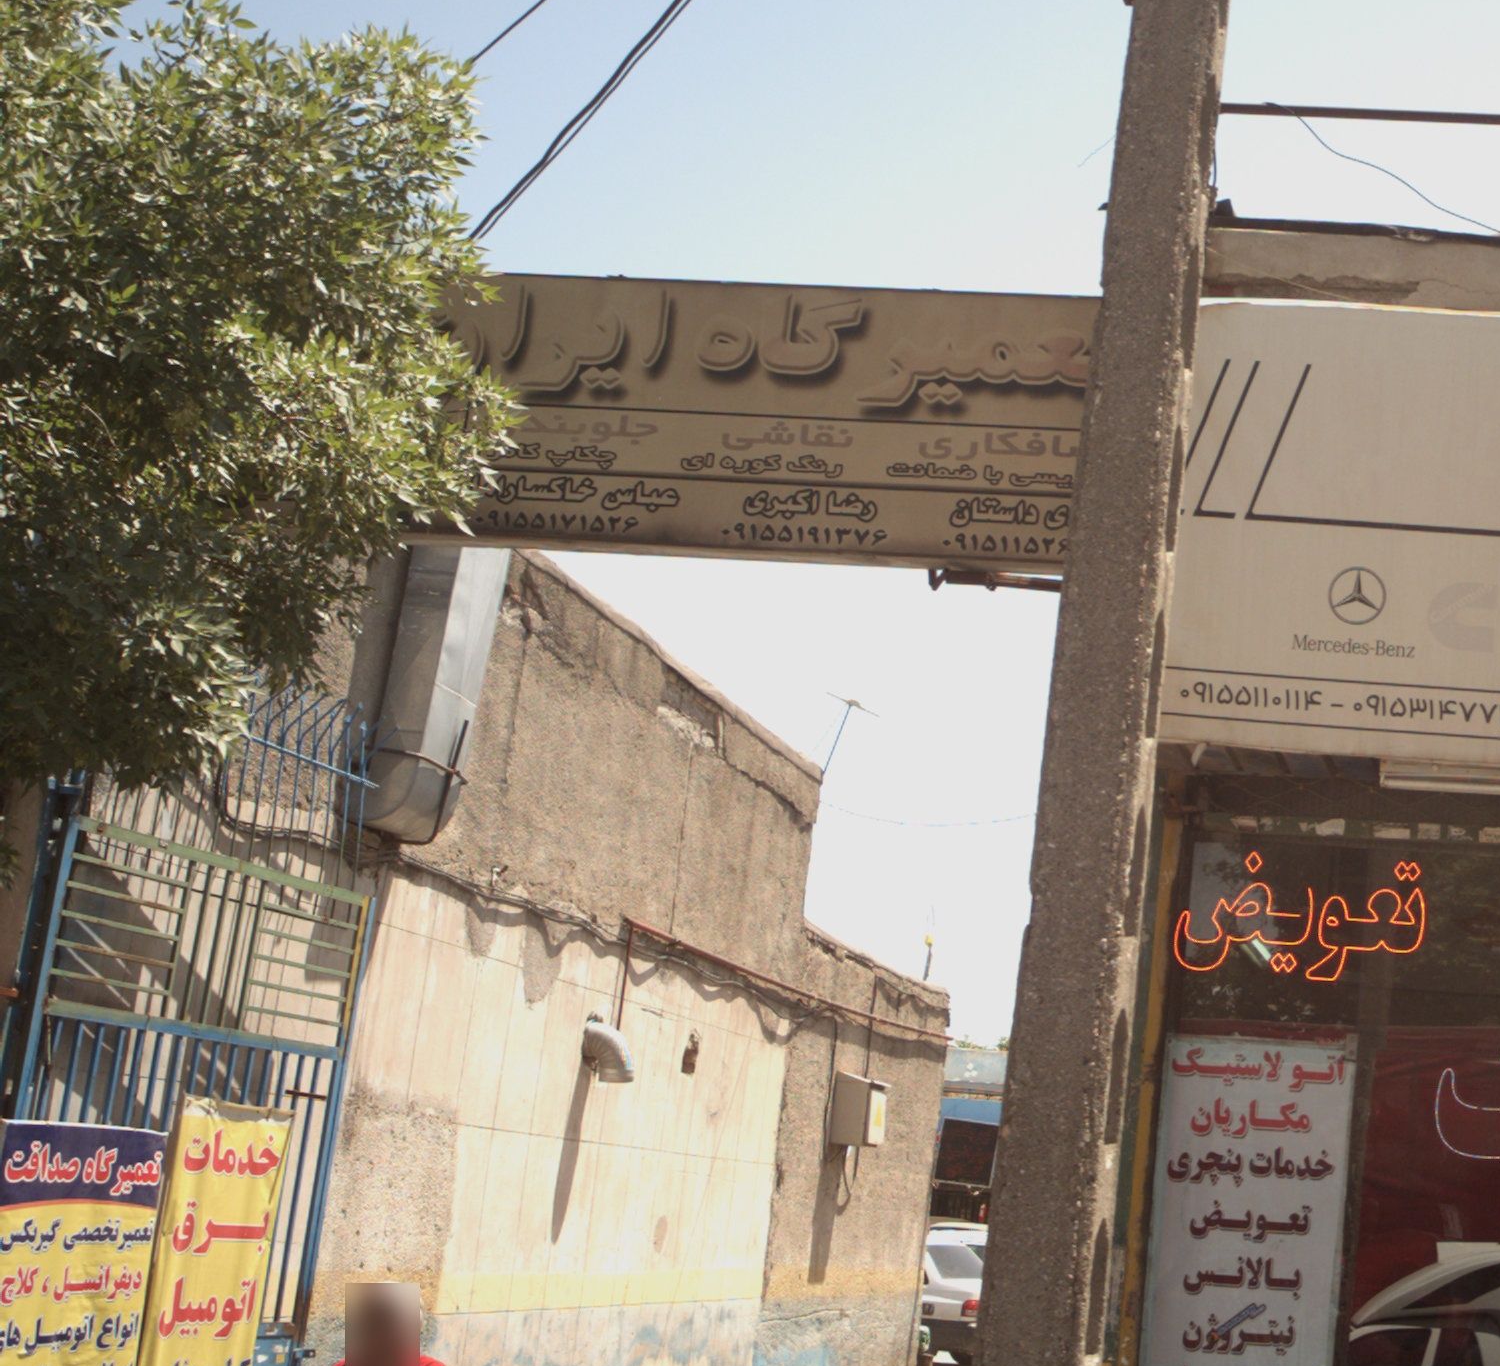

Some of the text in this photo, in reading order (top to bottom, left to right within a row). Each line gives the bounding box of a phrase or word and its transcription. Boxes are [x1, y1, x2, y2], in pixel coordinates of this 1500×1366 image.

[855, 329, 1094, 408] عمیر
[722, 420, 854, 451] نقاشی
[917, 431, 1080, 461] افکاری
[680, 452, 844, 479] رنگ کوره ای
[887, 461, 977, 482] ضمانت
[601, 480, 681, 513] عباس
[743, 488, 878, 523] رضا اکبری
[720, 522, 888, 546] ۰۹۱۵۵۱۹۱۳۷۶
[942, 533, 1071, 555] ۰۹۱۵۱۱۵۲۶
[1290, 633, 1417, 659] Mercedes-Benz
[1180, 680, 1323, 712] ۰۹۱۵۵۱۱۰۱۱۴
[1171, 850, 1427, 982] تعویض
[1170, 1046, 1284, 1085] لاستیک
[1190, 1097, 1312, 1138] مکاریان
[5, 1139, 82, 1184] صداقت
[183, 1128, 282, 1178] خدمات
[1166, 1146, 1336, 1187] خدمات پنچری
[172, 1200, 271, 1256] برق
[1189, 1199, 1313, 1244] تعویض
[1182, 1255, 1303, 1301] بالانس
[158, 1276, 257, 1339] اتومبیل
